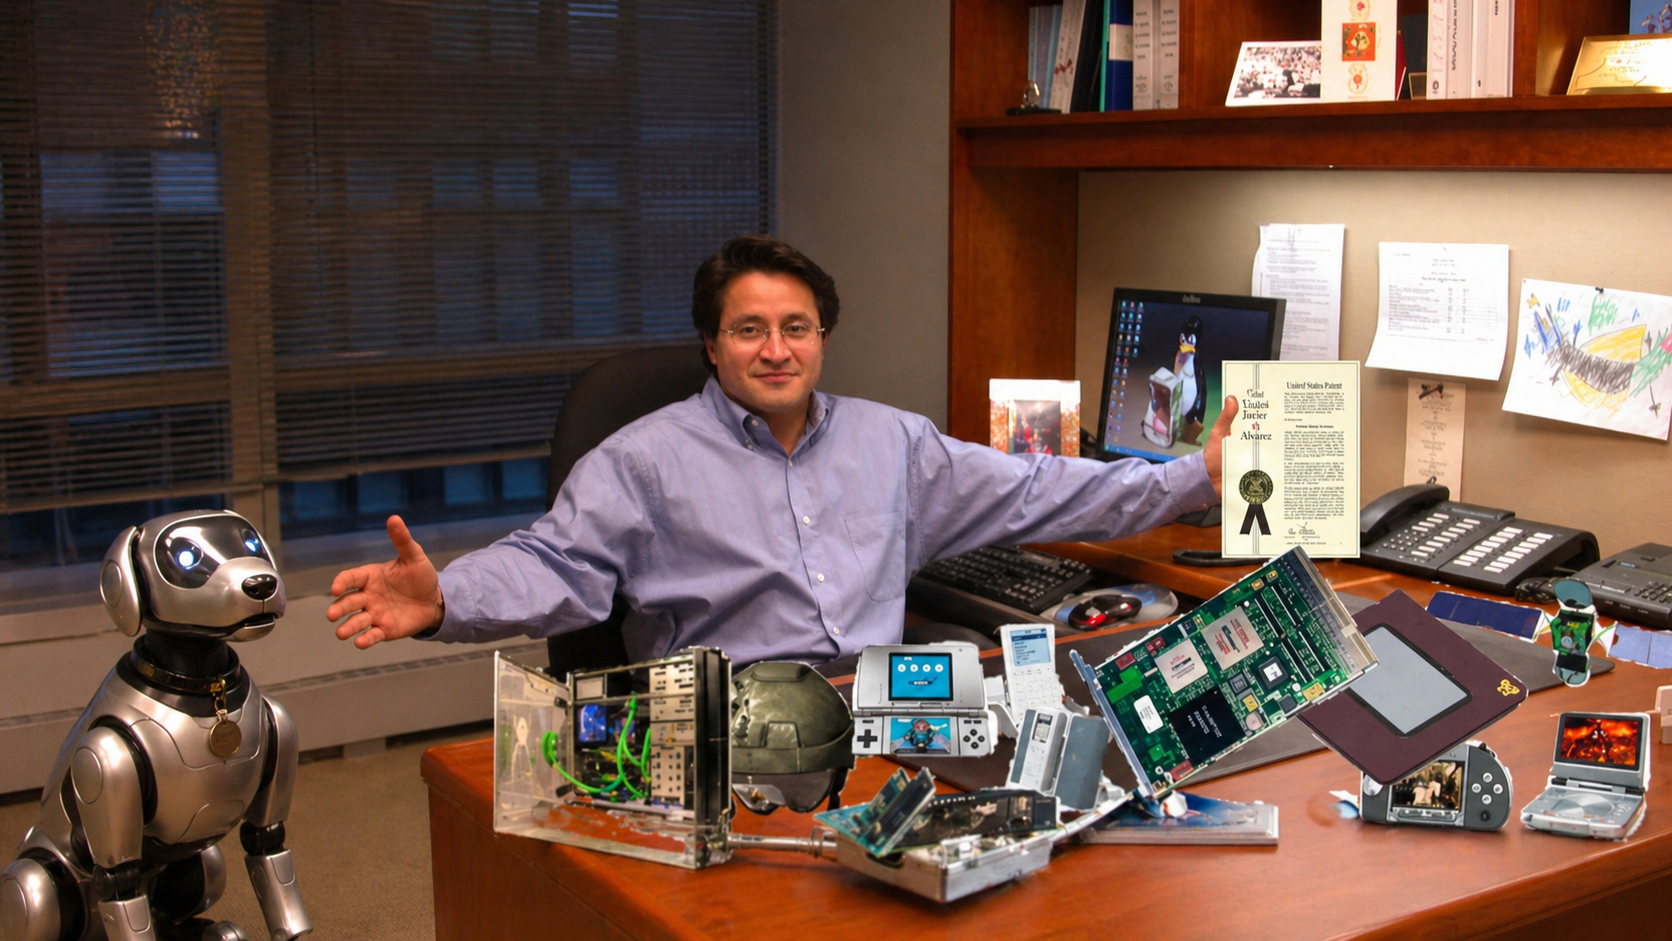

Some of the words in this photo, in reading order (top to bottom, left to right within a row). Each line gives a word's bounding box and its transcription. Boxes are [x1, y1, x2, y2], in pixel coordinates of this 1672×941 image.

[1286, 381, 1306, 390] United
[1306, 381, 1324, 390] States
[1324, 381, 1343, 390] Patent
[1240, 430, 1272, 440] Alvarez
